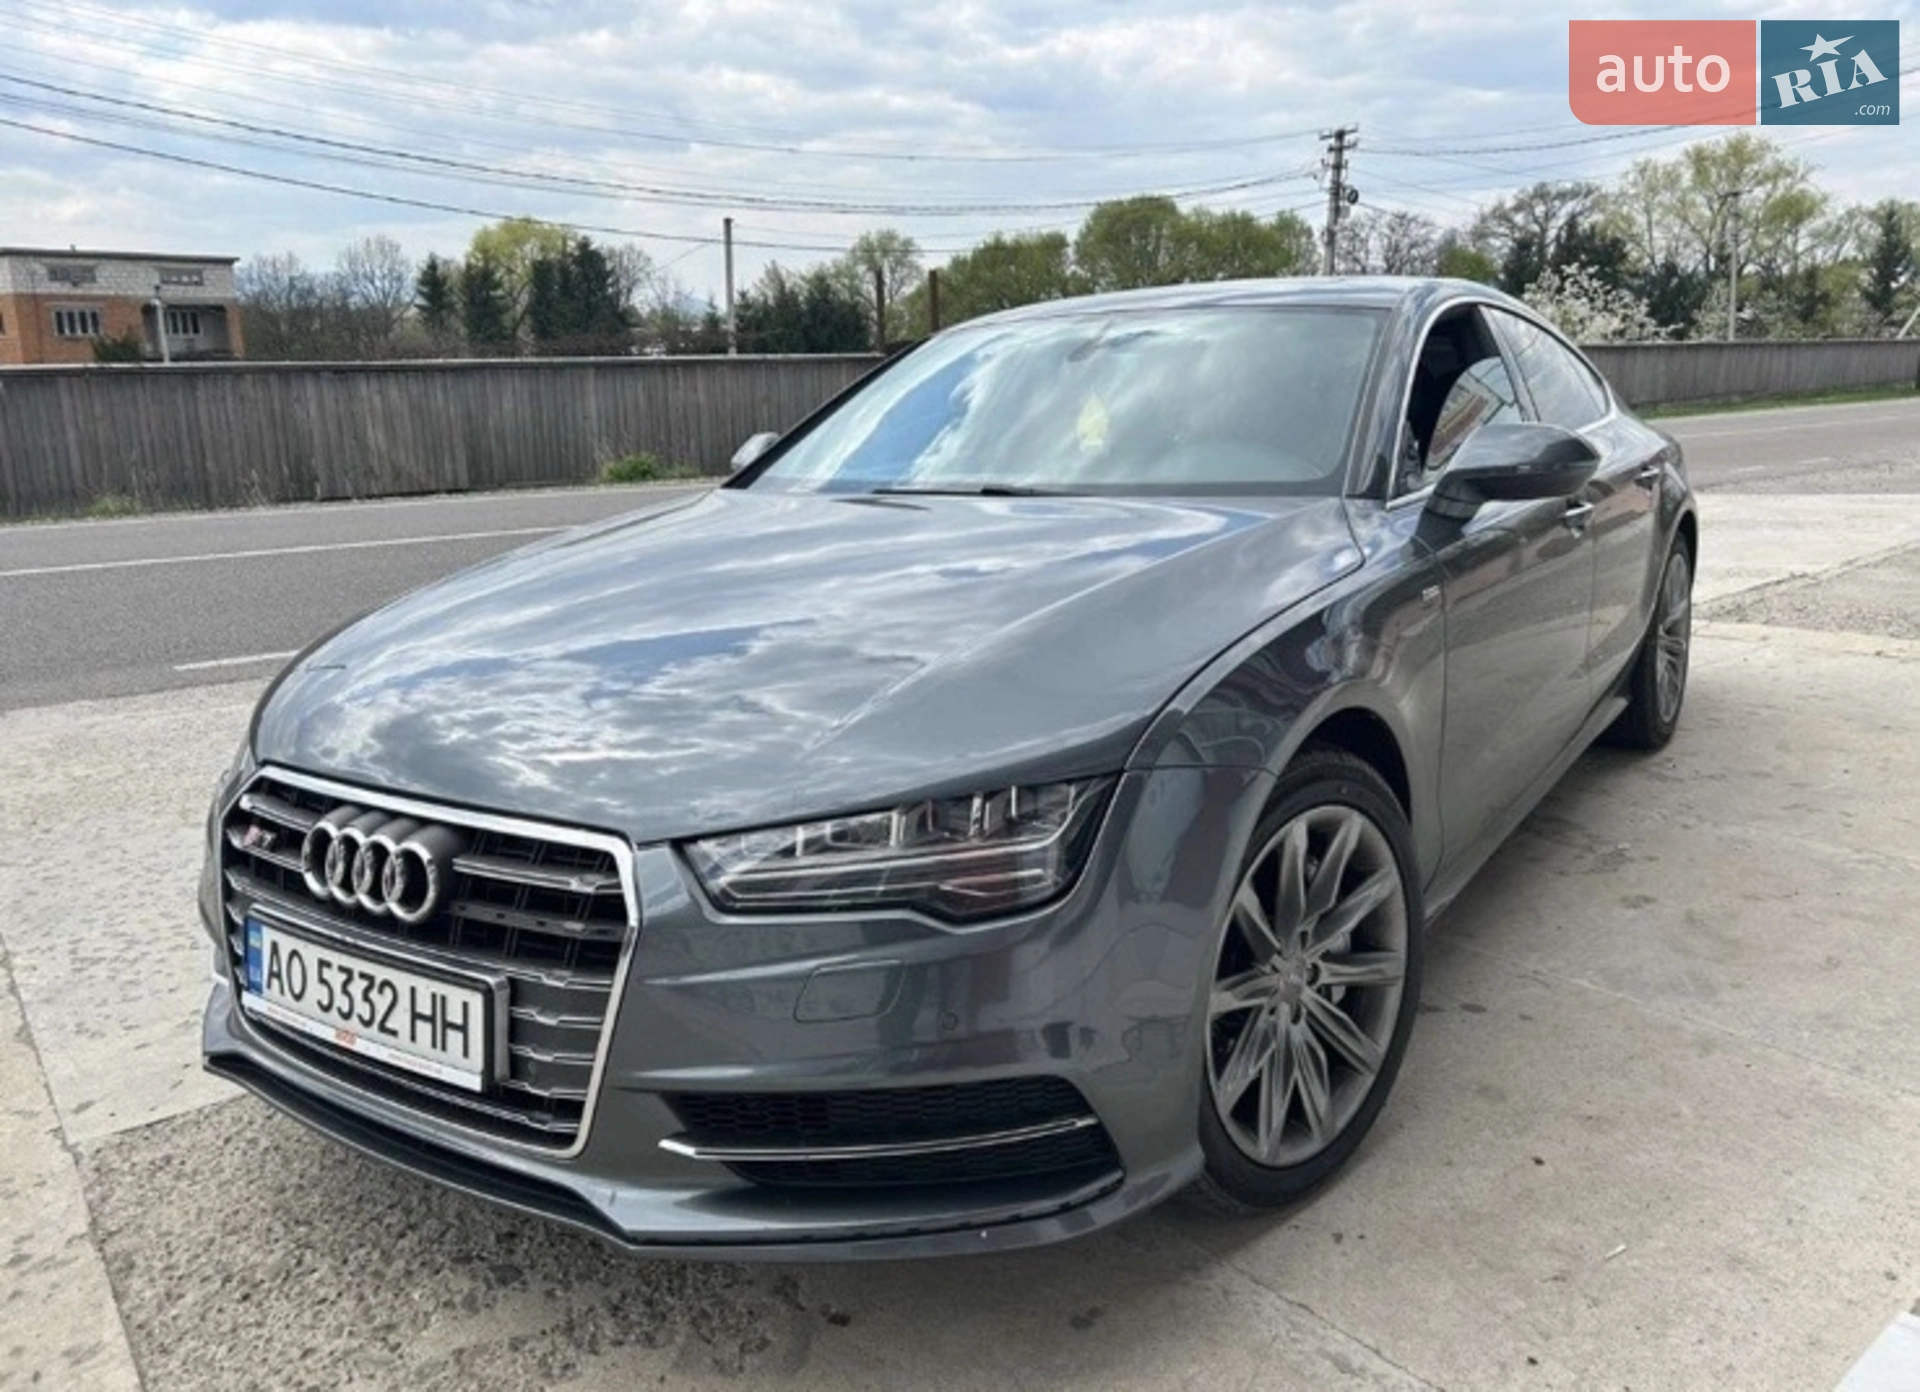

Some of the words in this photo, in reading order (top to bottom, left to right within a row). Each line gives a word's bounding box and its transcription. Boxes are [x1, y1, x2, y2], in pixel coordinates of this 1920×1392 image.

[266, 940, 307, 1002] AO
[316, 957, 399, 1038] 5332
[410, 985, 470, 1060] HH
